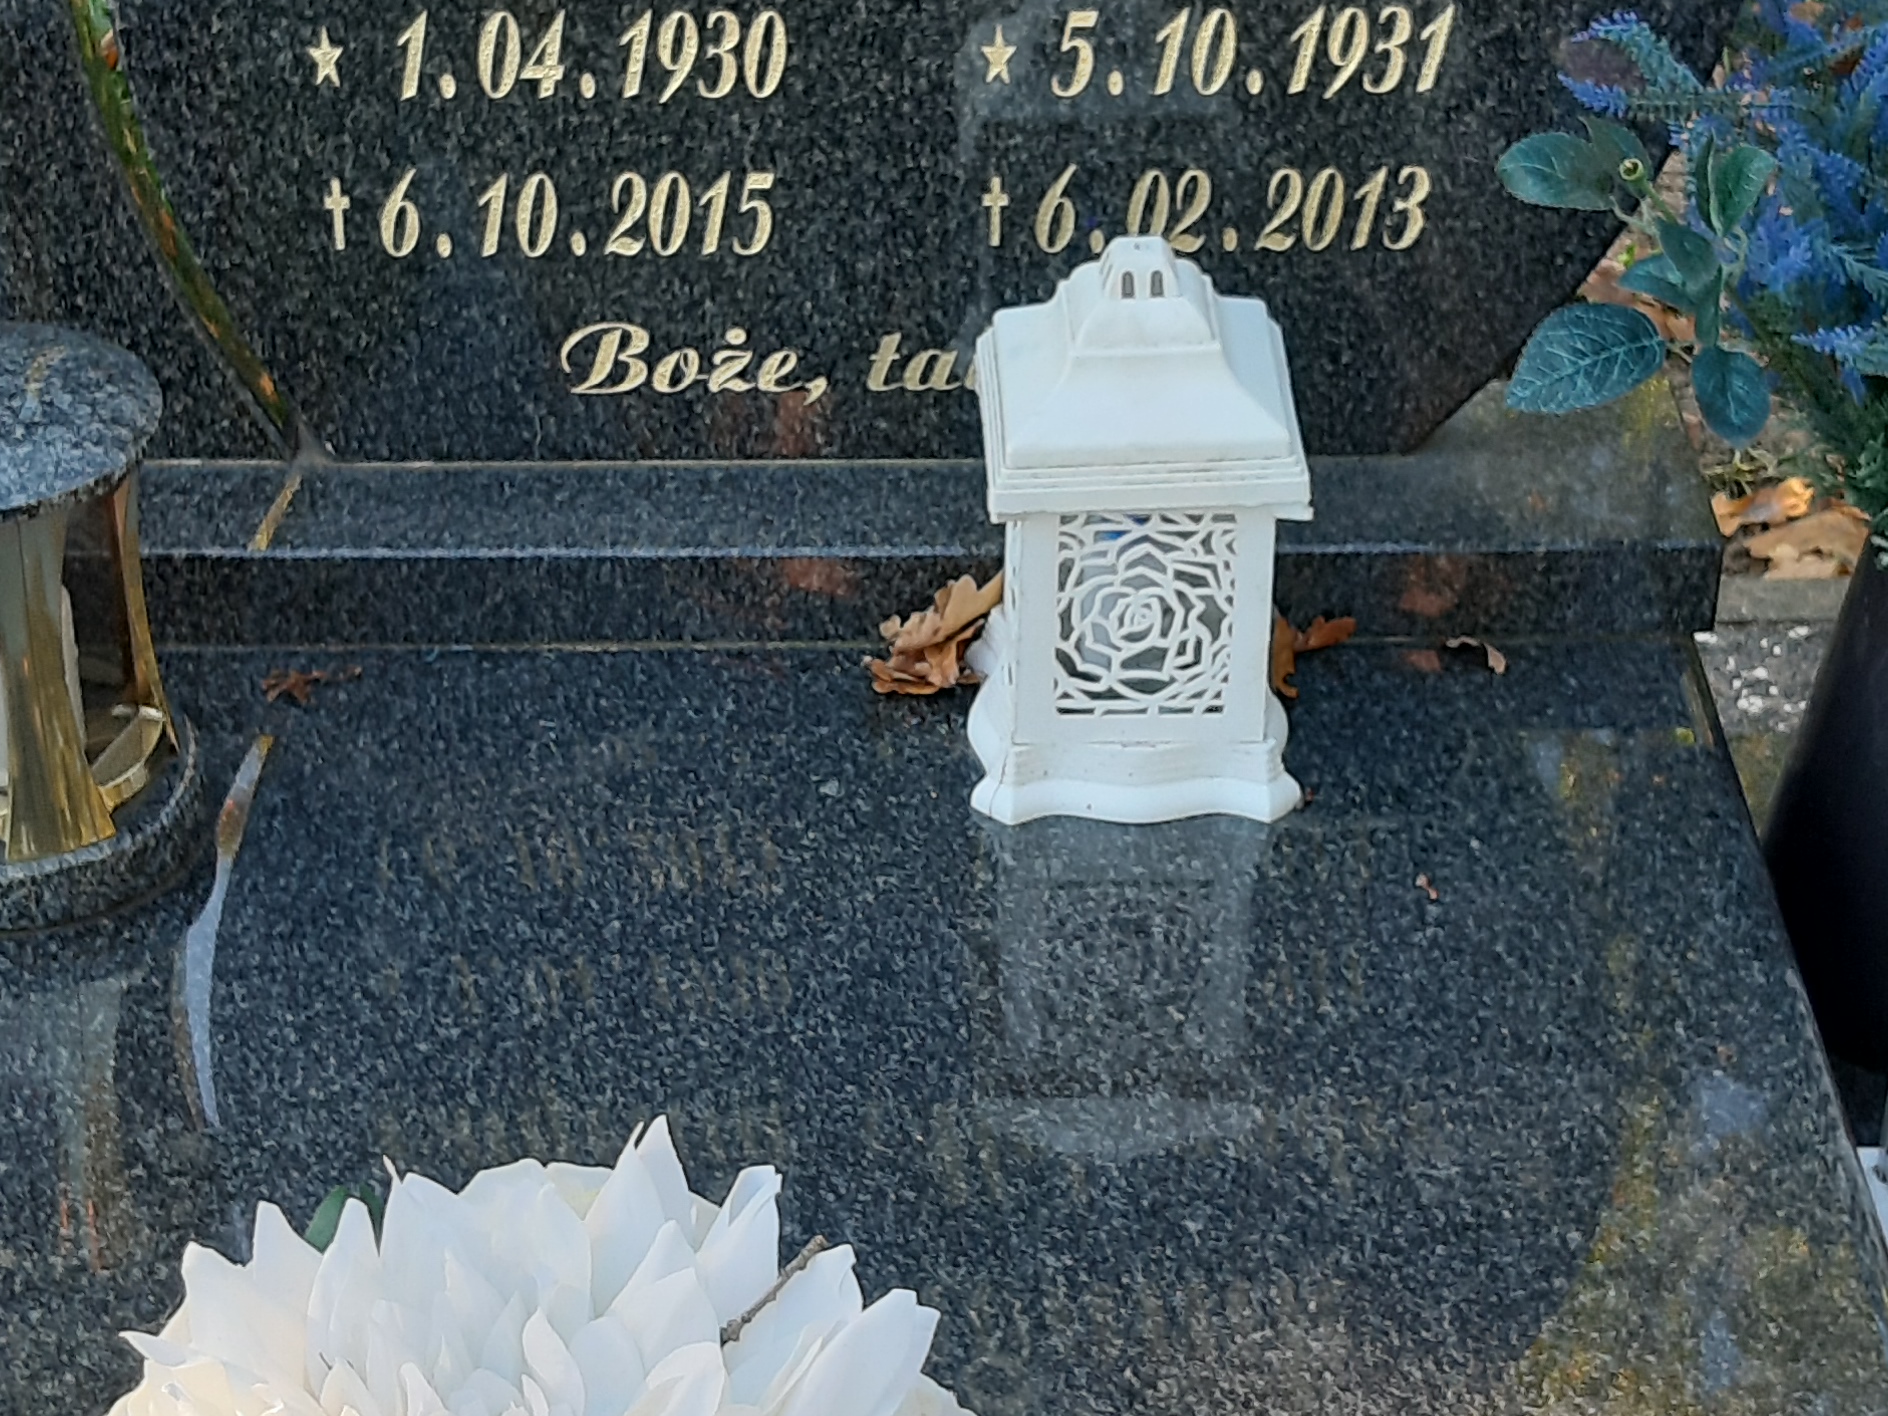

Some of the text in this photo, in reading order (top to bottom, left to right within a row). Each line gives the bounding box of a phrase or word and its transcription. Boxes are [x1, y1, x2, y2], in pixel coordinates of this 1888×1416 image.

[398, 9, 789, 101] 1.04.1930
[1051, 3, 1456, 98] 5.10.1931
[378, 168, 776, 257] 6.10.2015
[1034, 162, 1432, 254] 6.02.2013
[560, 321, 977, 406] Boże, ta
